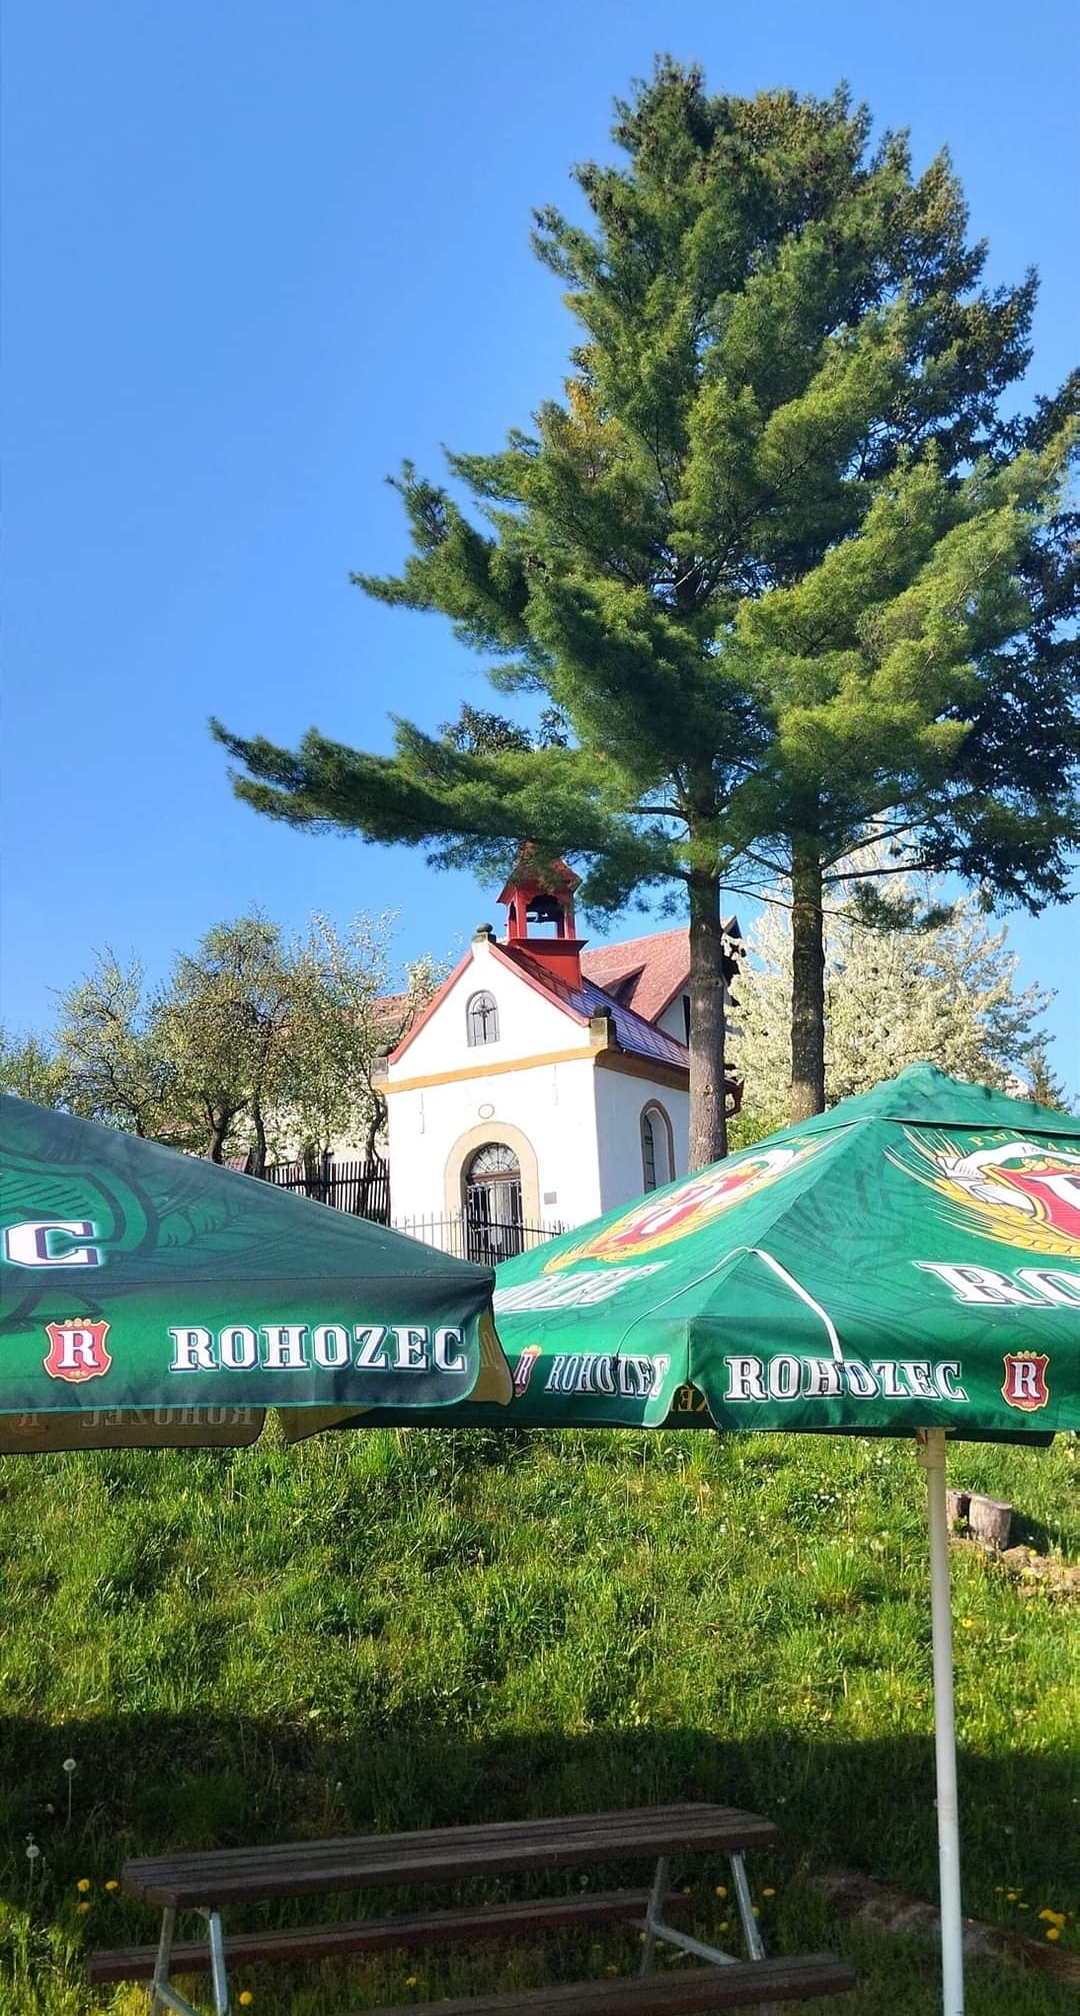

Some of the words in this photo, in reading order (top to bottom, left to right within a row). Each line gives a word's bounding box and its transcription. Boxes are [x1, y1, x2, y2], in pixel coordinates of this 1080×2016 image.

[5, 1221, 99, 1267] C
[57, 1330, 101, 1369] R
[168, 1325, 466, 1372] ROHOZEC
[724, 1355, 968, 1401] ROHOZEC
[1011, 1361, 1039, 1399] R
